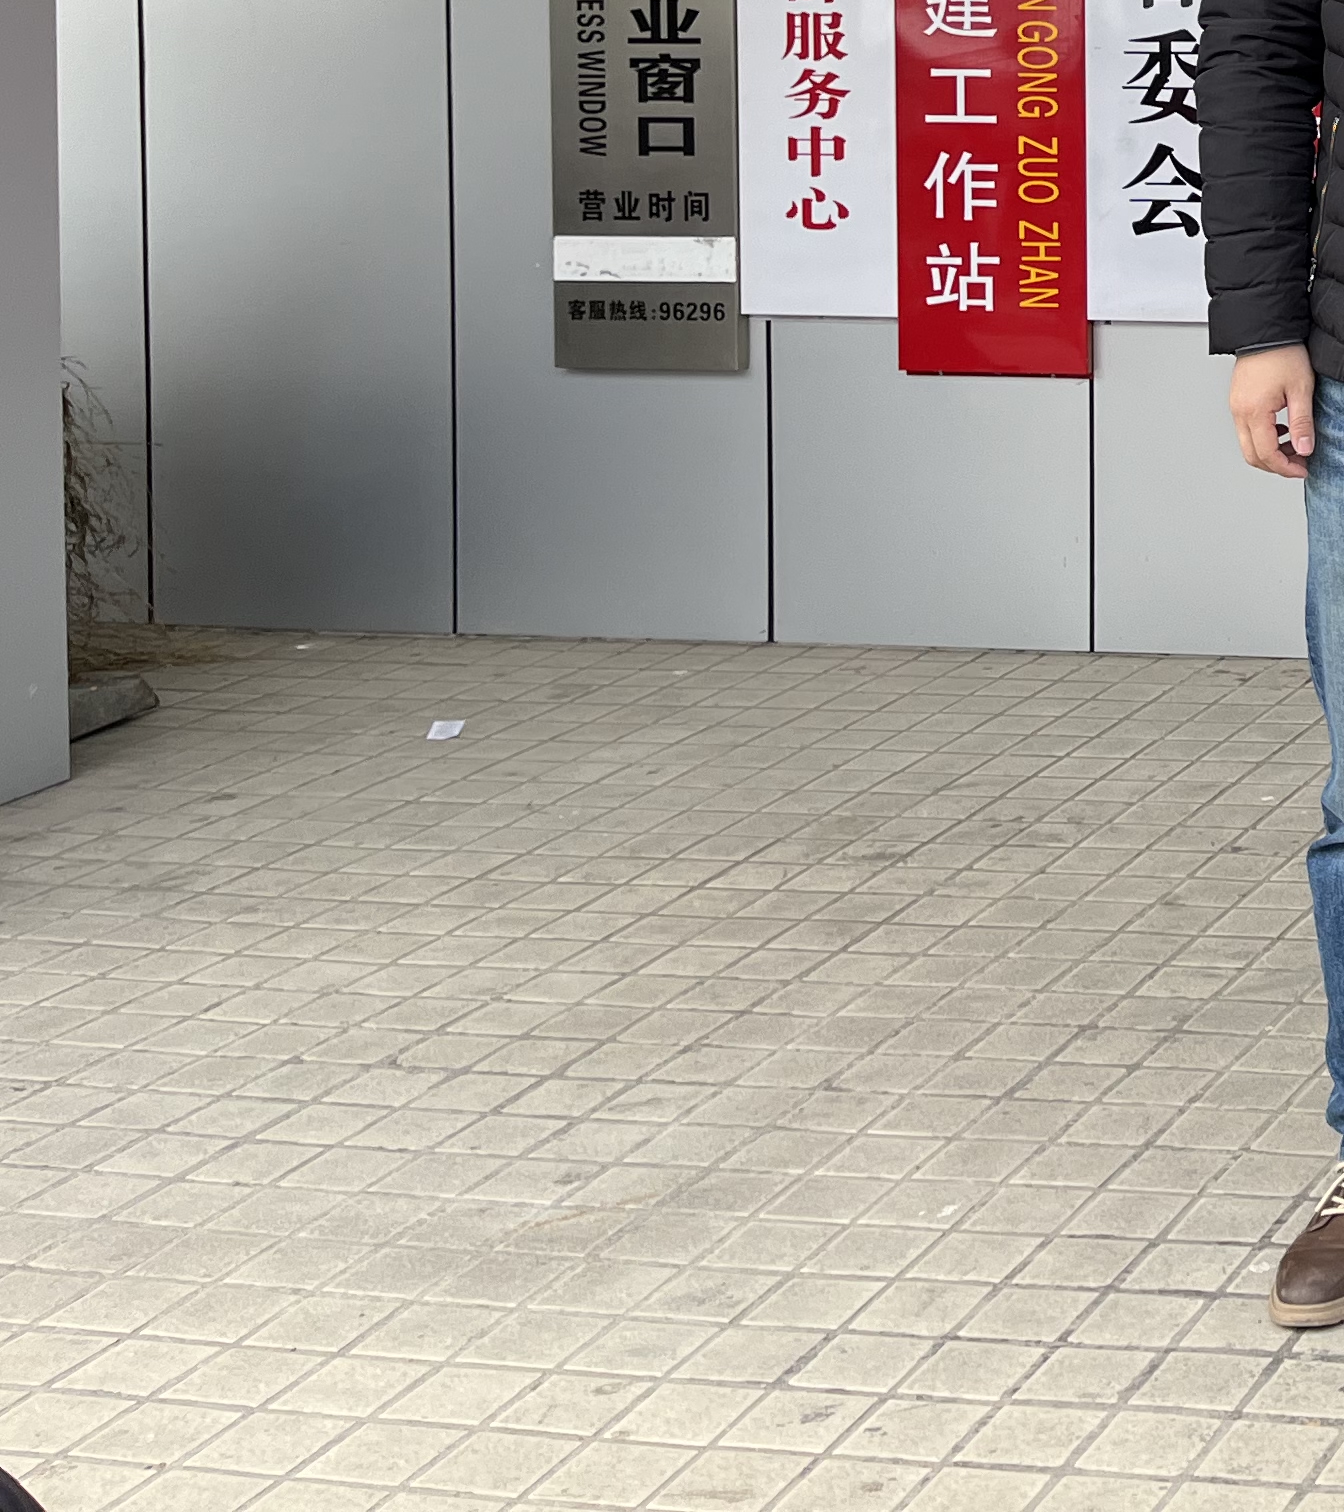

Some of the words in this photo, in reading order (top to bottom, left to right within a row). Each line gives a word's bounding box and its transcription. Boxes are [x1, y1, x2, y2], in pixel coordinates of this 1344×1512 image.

[577, 49, 606, 156] WINDOW
[1017, 20, 1059, 118] GONG
[576, 188, 710, 223] 营业时间
[1018, 135, 1060, 204] ZUO
[1018, 220, 1061, 308] ZHAN
[567, 298, 726, 322] 客服热线:96296
